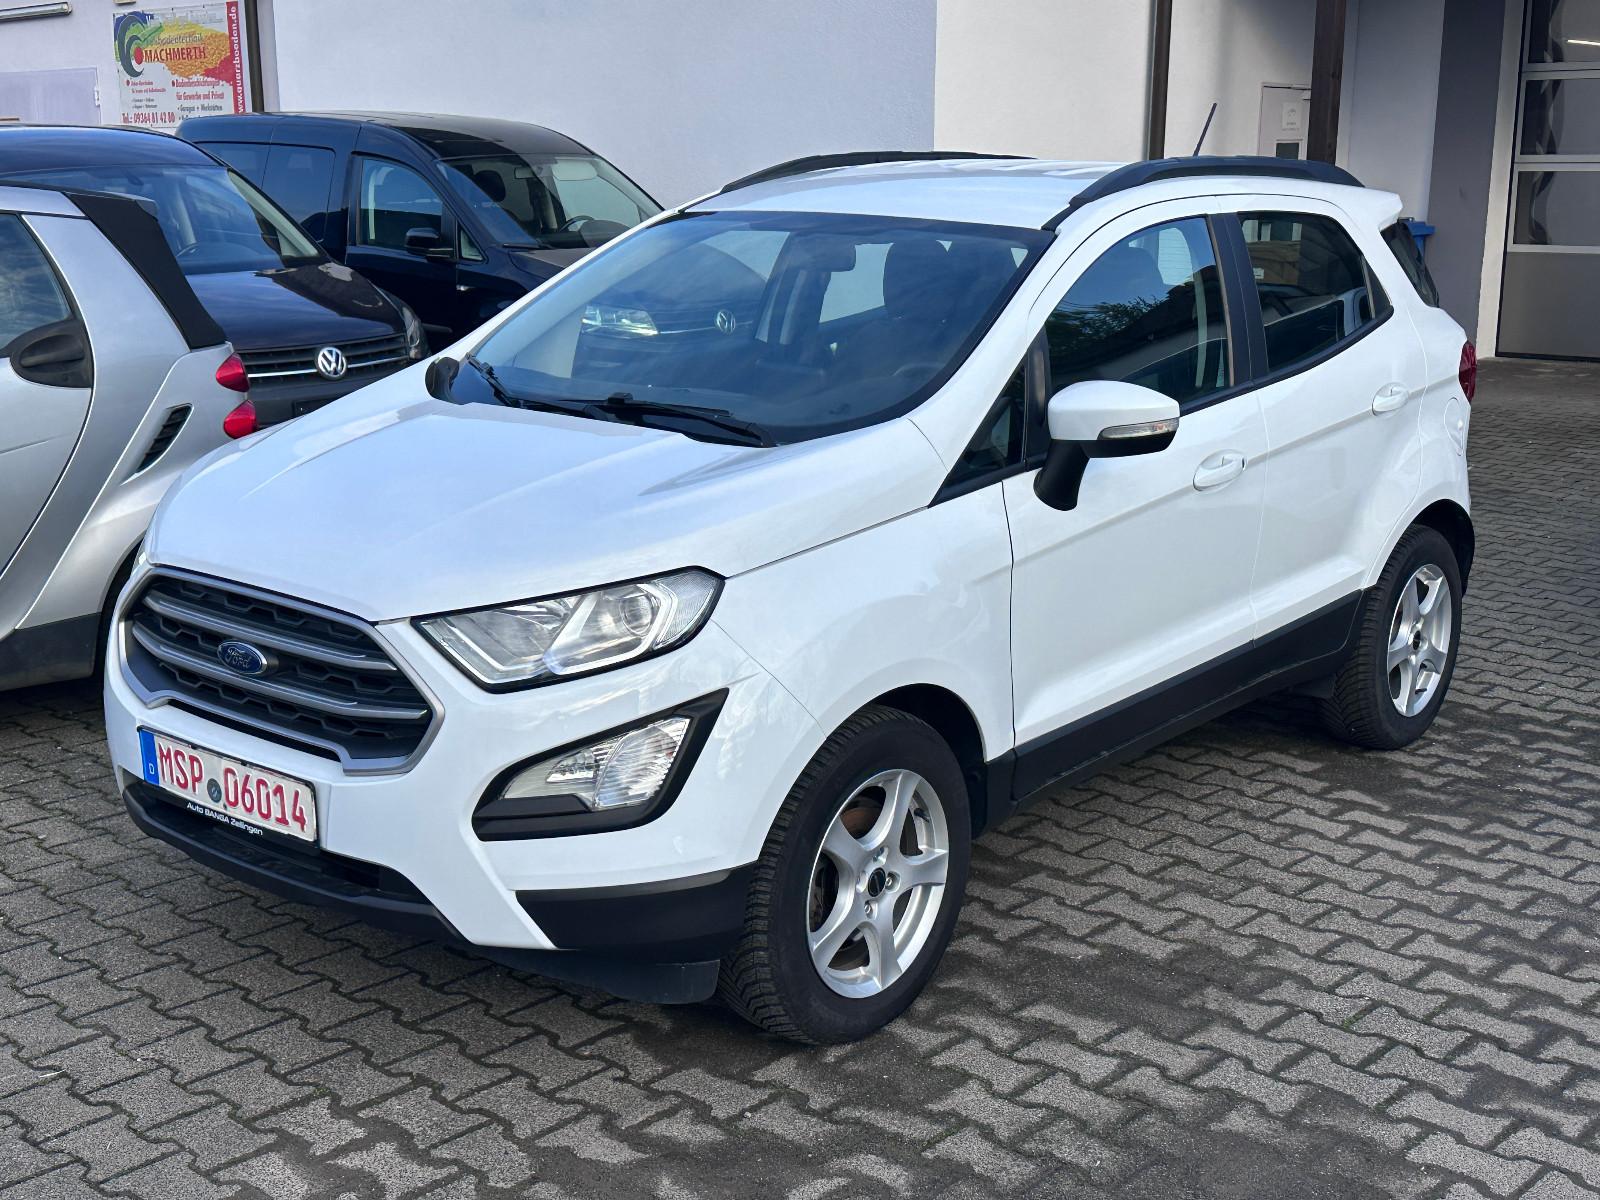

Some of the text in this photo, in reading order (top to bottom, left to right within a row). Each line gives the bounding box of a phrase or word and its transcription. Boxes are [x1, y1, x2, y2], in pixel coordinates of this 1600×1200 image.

[144, 46, 207, 63] MACHMERTH
[158, 742, 307, 832] MSP 06014
[187, 802, 264, 836] Auto BANGA Zellingen
